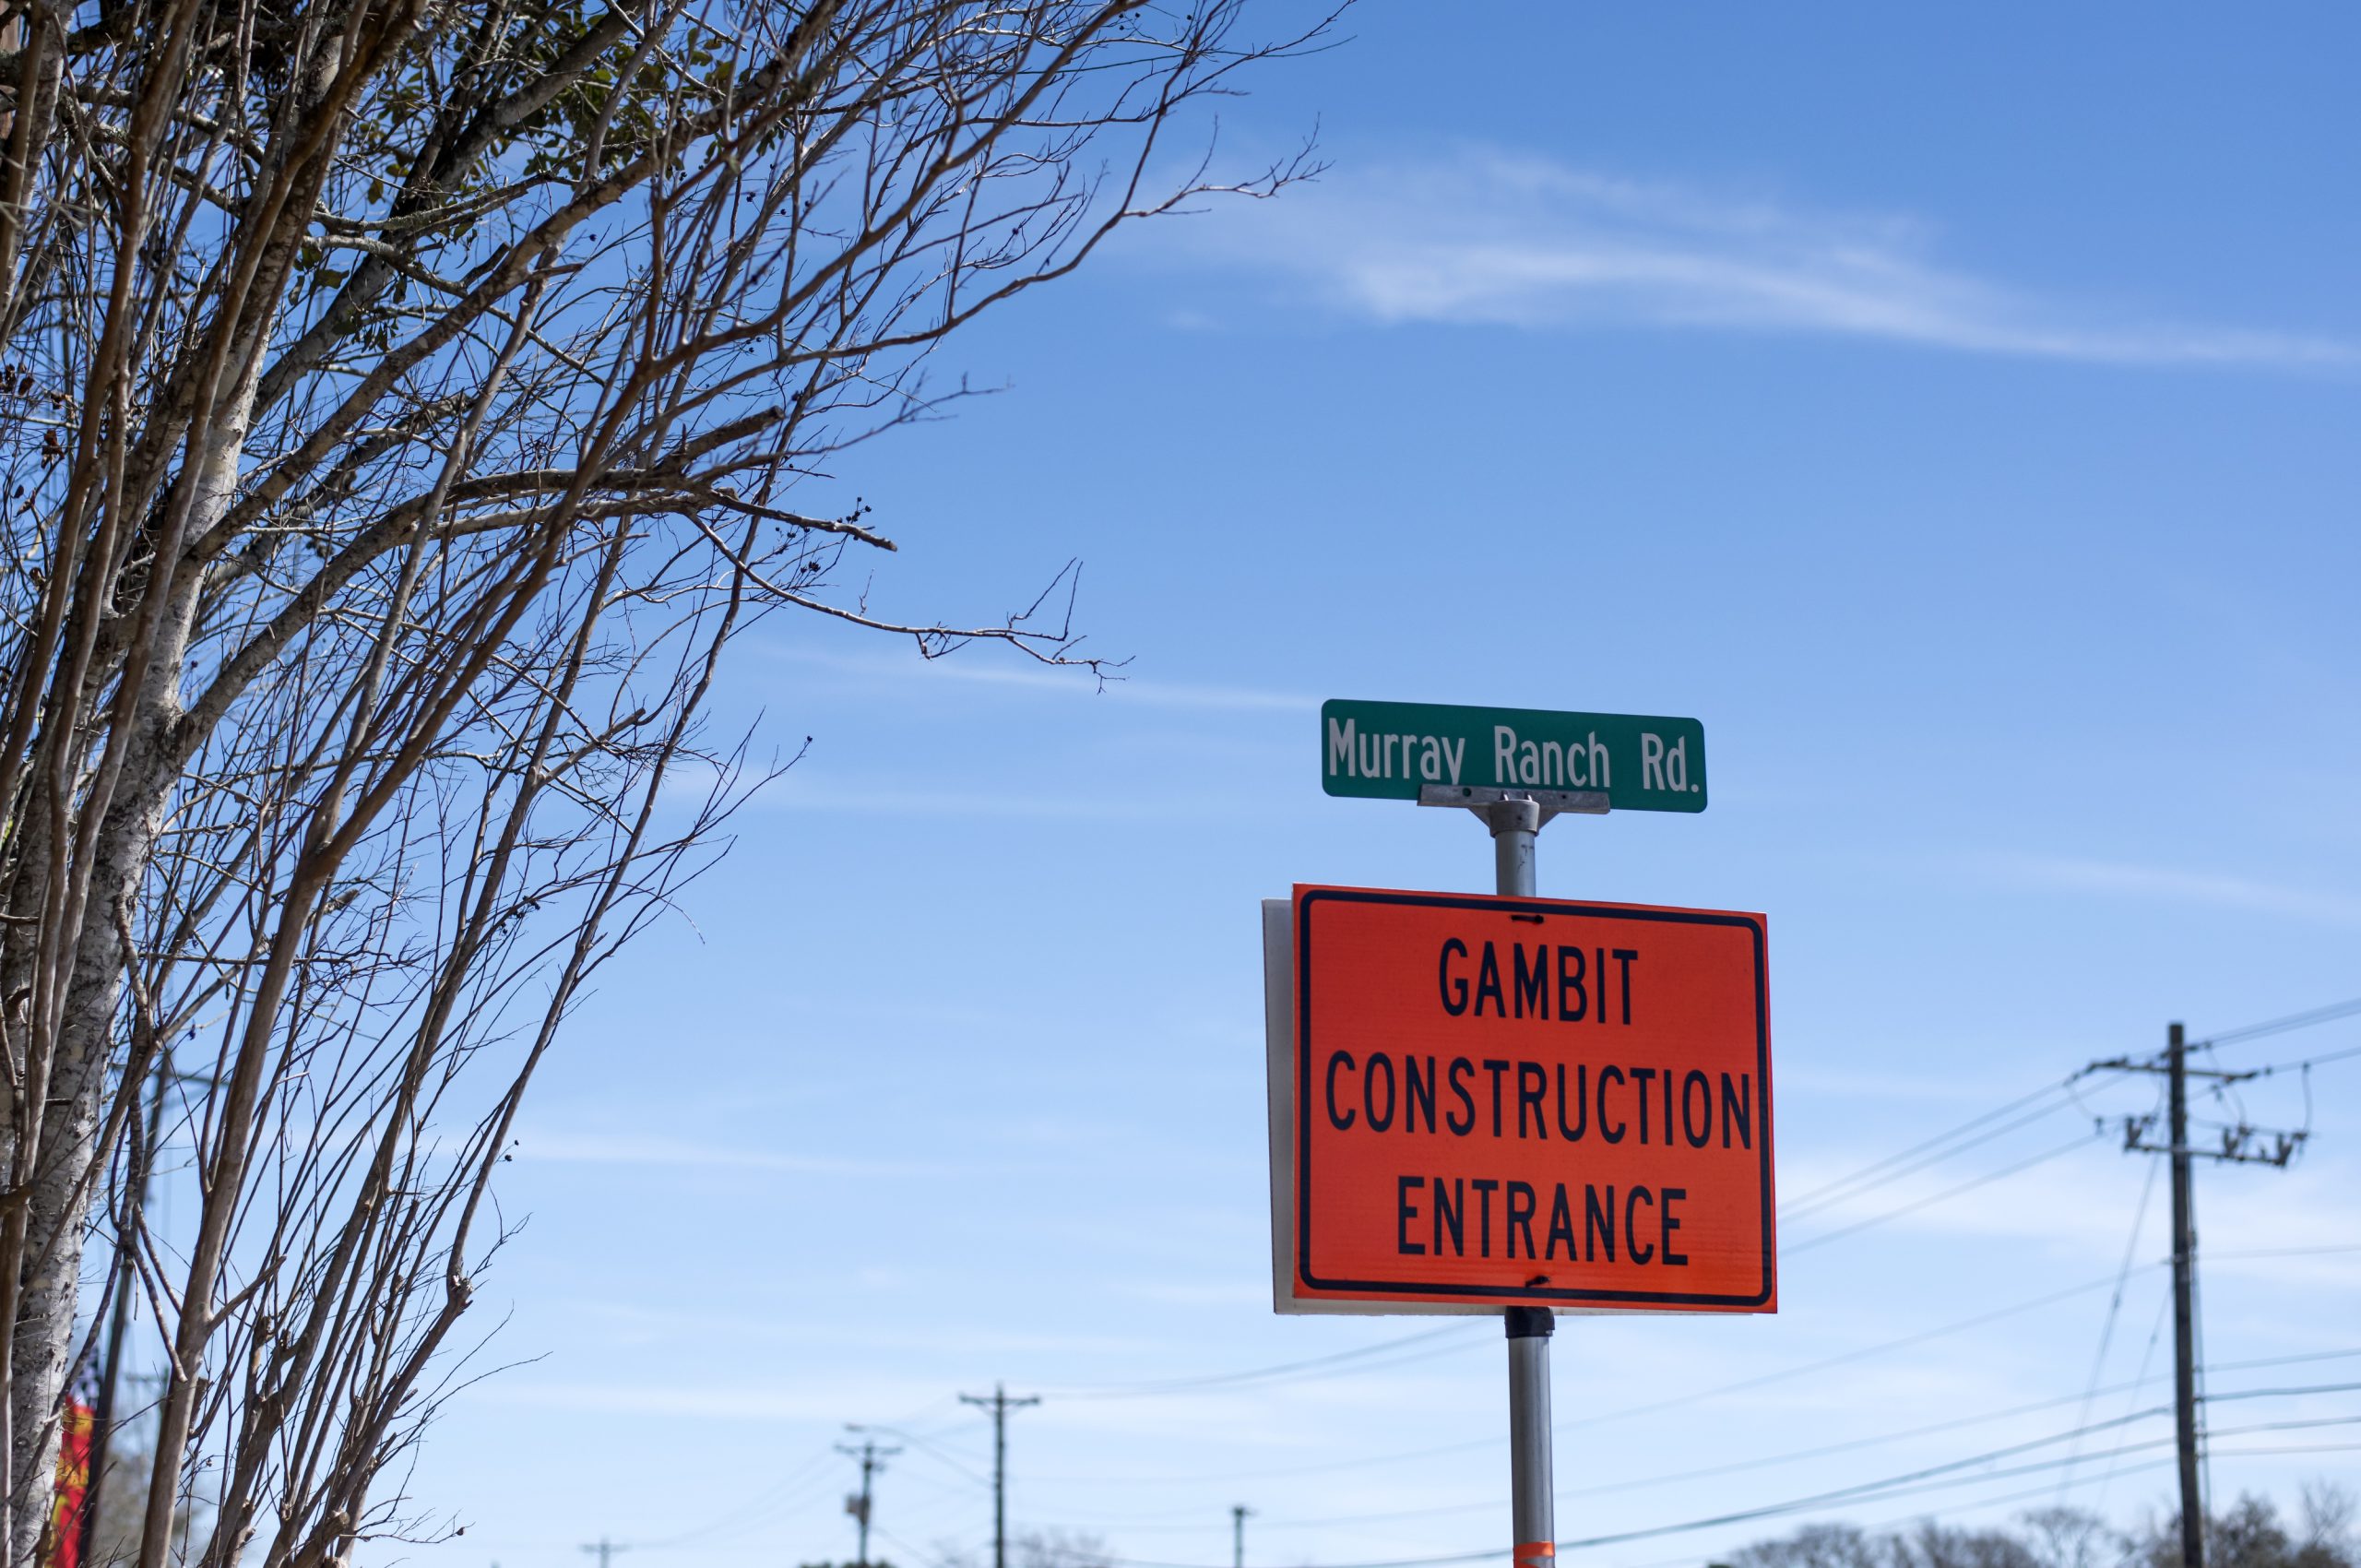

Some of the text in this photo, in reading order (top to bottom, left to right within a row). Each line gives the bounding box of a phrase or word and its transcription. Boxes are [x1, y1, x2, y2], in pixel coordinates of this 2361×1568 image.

[1328, 717, 1700, 793] Murray Ranch Rd.
[1439, 937, 1638, 1025] GAMBIT
[1326, 1050, 1751, 1149] CONSTRUCTION
[1397, 1175, 1689, 1265] ENTRANCE
